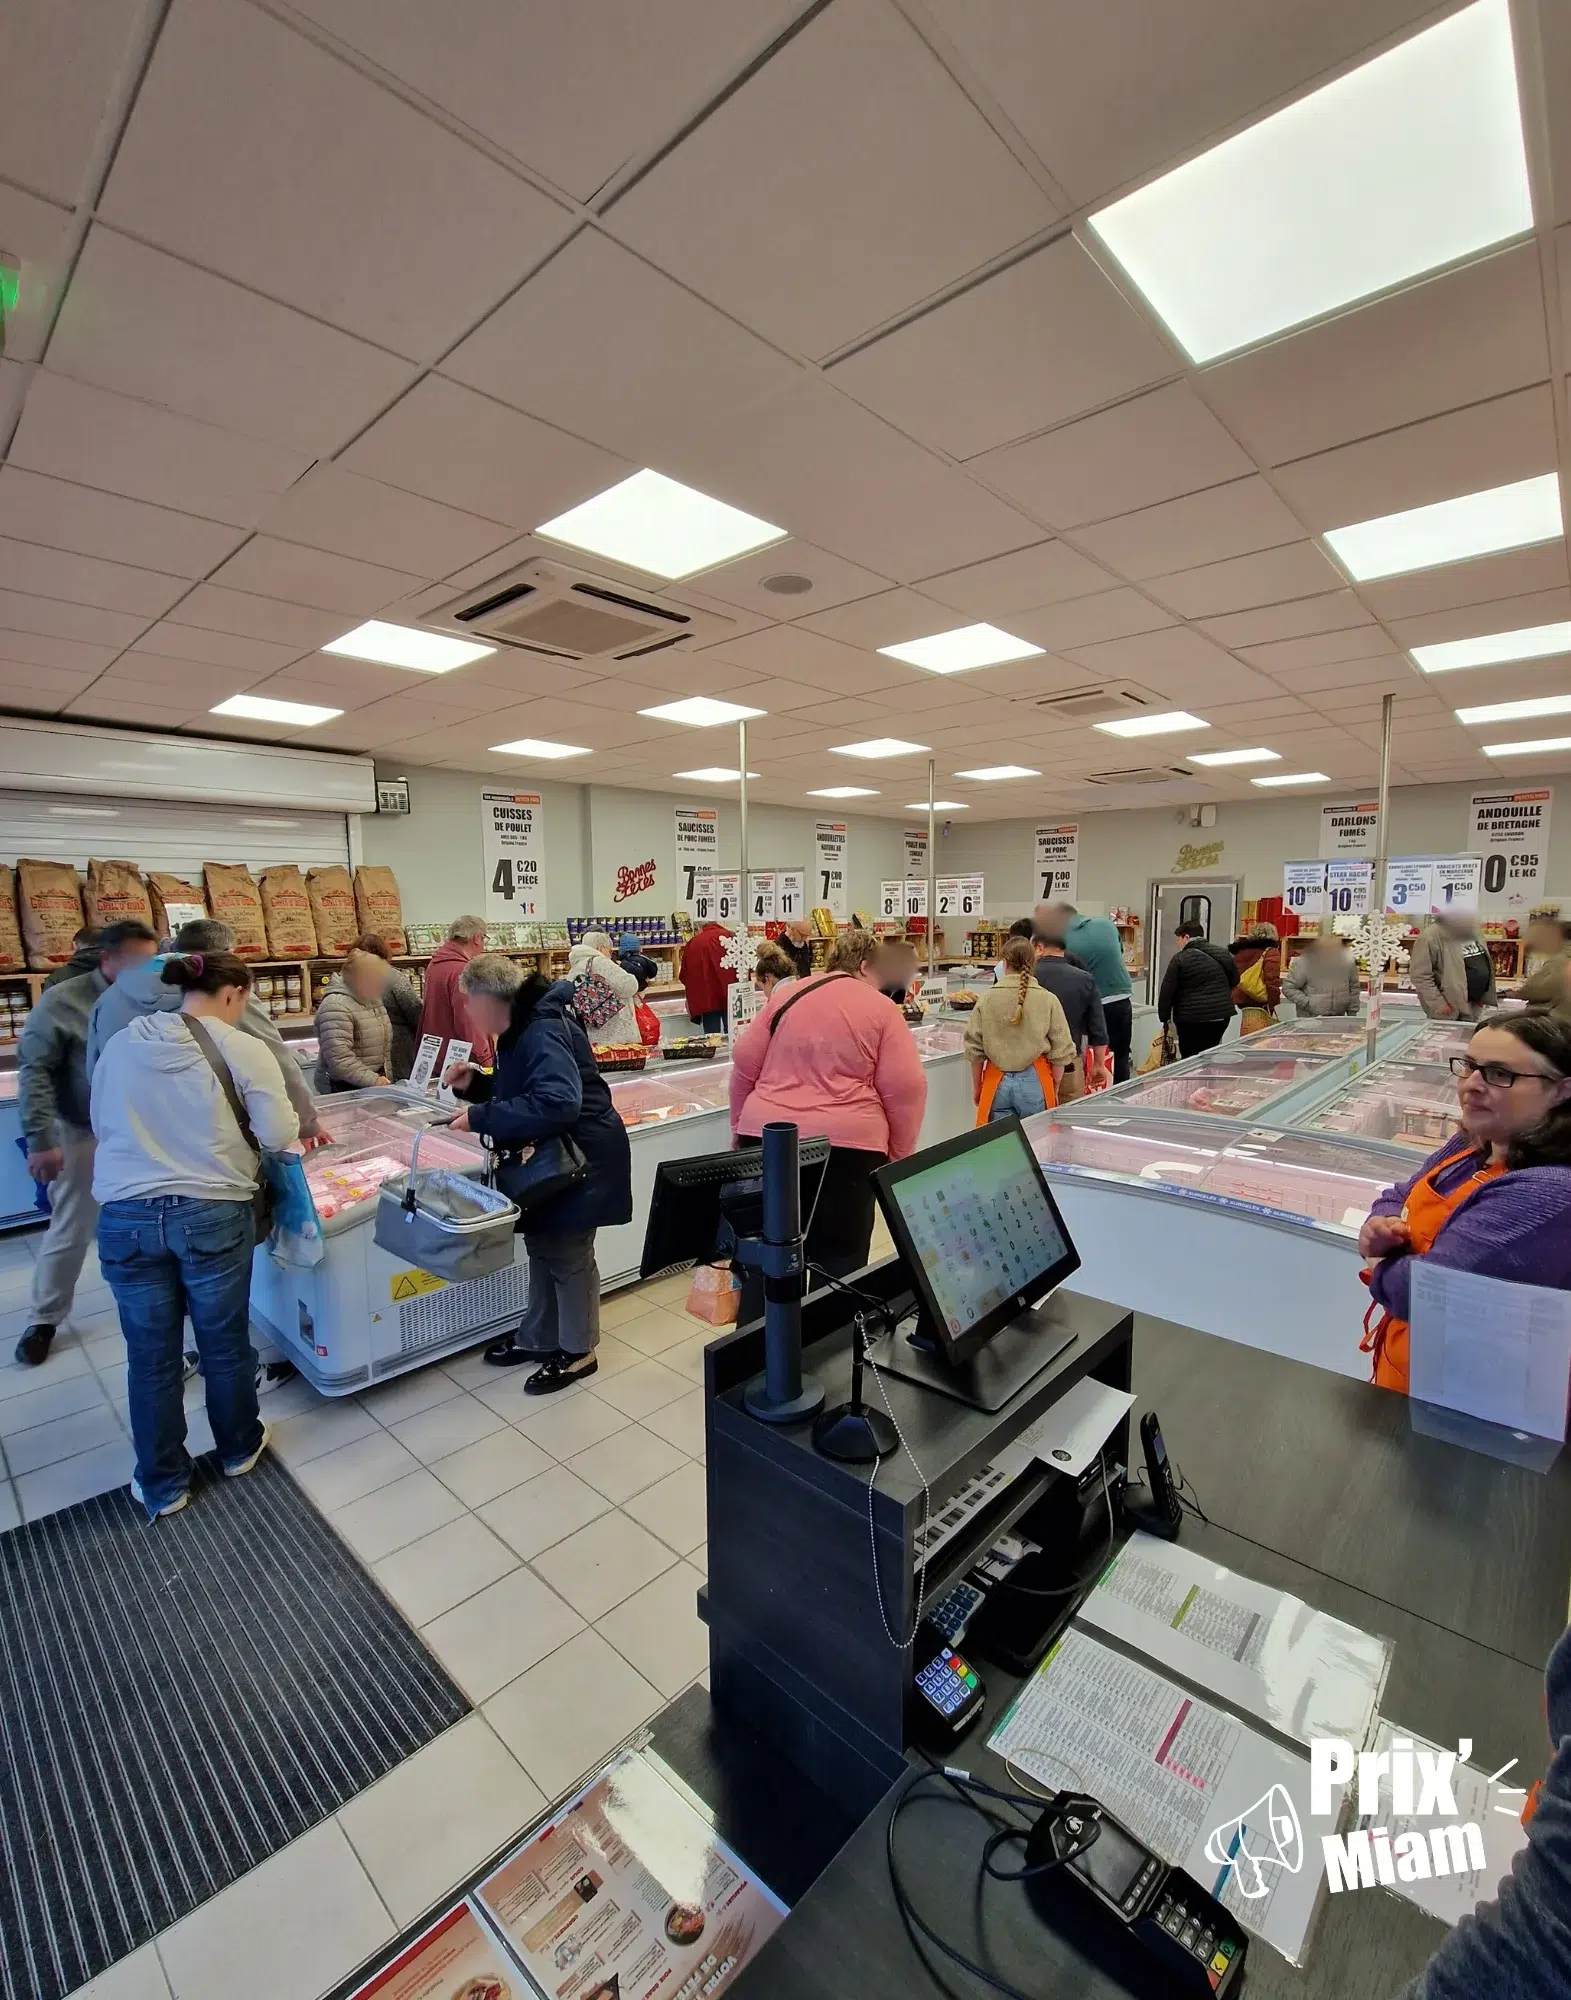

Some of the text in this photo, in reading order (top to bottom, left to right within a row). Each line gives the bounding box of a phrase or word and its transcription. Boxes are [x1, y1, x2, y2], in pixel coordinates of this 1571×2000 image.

[493, 807, 532, 820] CUISSES
[1331, 816, 1376, 826] DARLONS
[1477, 806, 1542, 819] ANDOUILLE
[494, 822, 532, 833] DE POULET
[678, 822, 714, 834] SAUCISSES
[1340, 827, 1366, 837] FUMÉS
[1477, 819, 1541, 830] DE BRETAGNE
[1038, 836, 1074, 846] SAUCISSES
[492, 859, 516, 900] 4
[518, 874, 538, 884] PIÈCE
[617, 859, 656, 882] Bonnes
[1510, 868, 1536, 878] LE KG
[683, 866, 696, 900] 7
[821, 870, 830, 900] 7
[1041, 872, 1054, 899] 7
[1287, 886, 1306, 906] 10
[1329, 888, 1352, 912] 10
[1392, 884, 1408, 905] 3
[1442, 883, 1454, 904] 1
[696, 898, 708, 918] 18
[720, 898, 729, 918] 9
[754, 896, 764, 916] 4
[782, 894, 792, 913] 11
[884, 898, 892, 914] 8
[906, 898, 918, 914] 10
[940, 897, 948, 914] 2
[963, 896, 972, 914] 6
[700, 1954, 717, 1974] DE
[660, 1968, 672, 1983] FOIE
[702, 1956, 737, 1996] VOTRE
